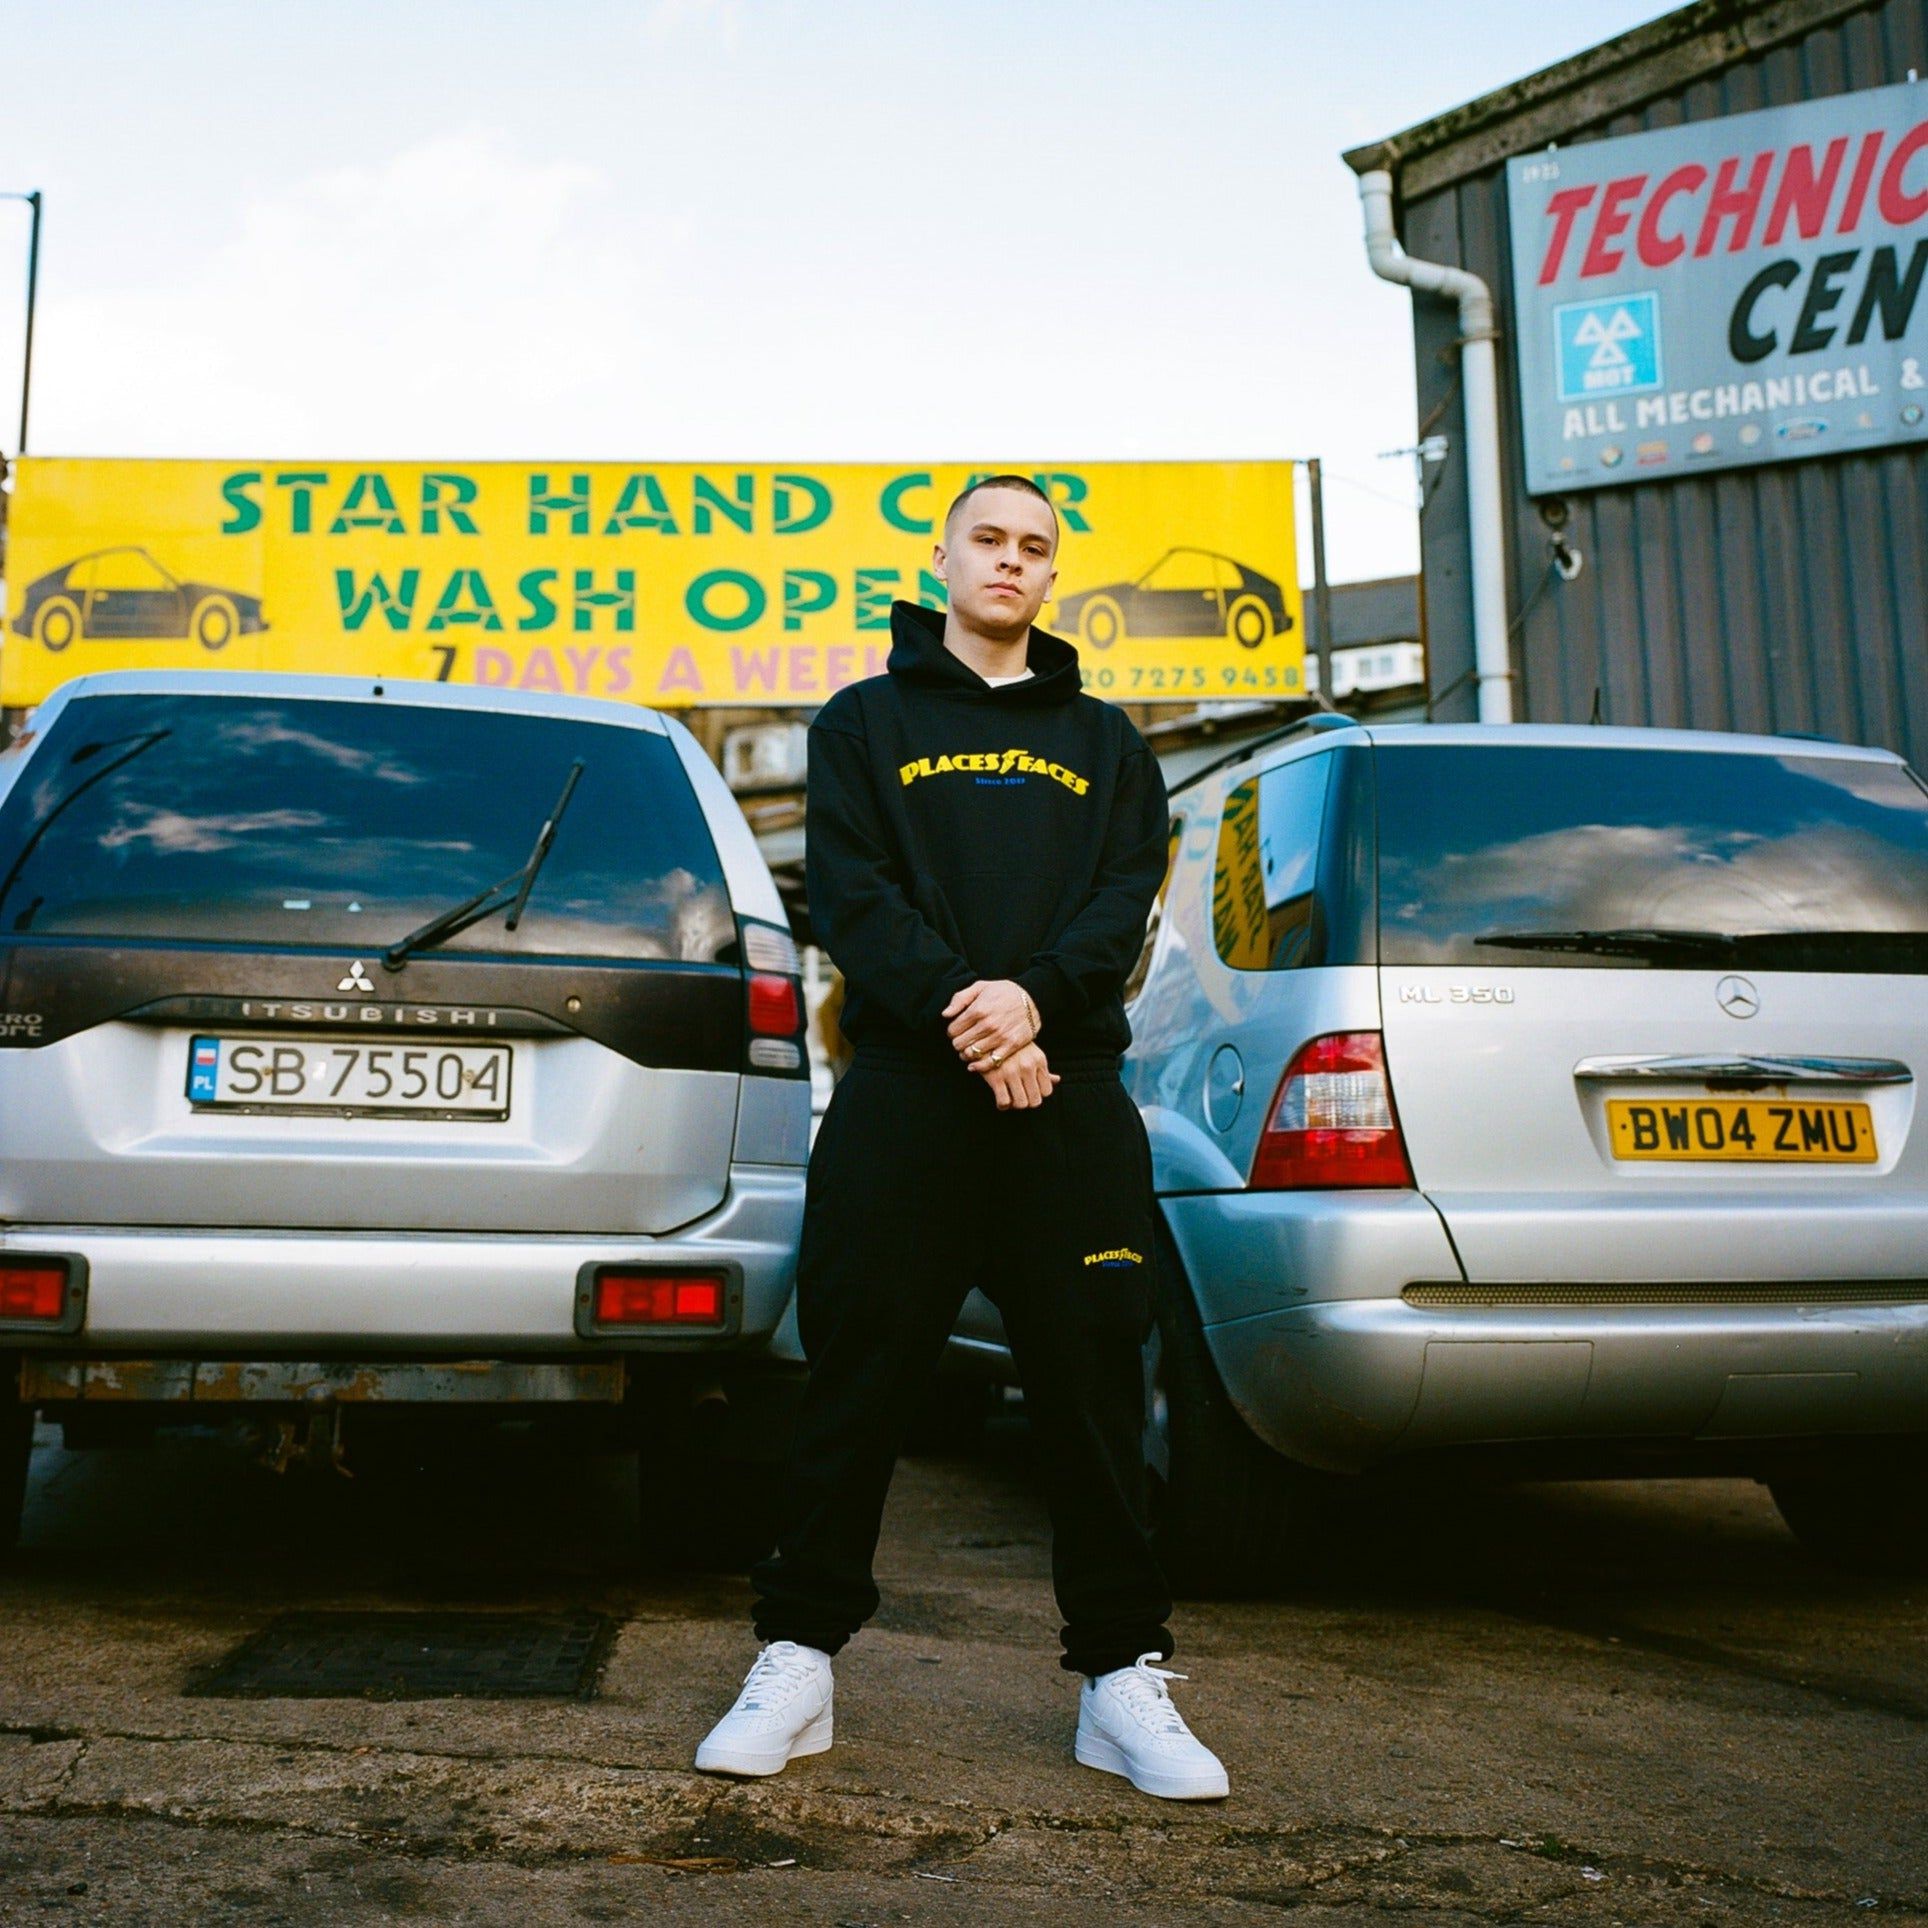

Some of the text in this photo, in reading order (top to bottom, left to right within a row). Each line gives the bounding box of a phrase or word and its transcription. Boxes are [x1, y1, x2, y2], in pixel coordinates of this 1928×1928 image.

[1536, 119, 1928, 287] TECHNIC
[1728, 237, 1928, 365] CEN
[1562, 357, 1925, 441] ALL MECHANICAL &
[220, 472, 1093, 535] STAR HAND CR
[334, 569, 636, 632] WASH
[431, 645, 457, 682] 7
[474, 645, 632, 692] DAYS
[658, 646, 704, 692] A
[1129, 668, 1207, 689] 7275
[1221, 667, 1300, 688] 9458
[900, 753, 1090, 796] PLACES FACES
[242, 1002, 497, 1026] ITSUBISHI
[1399, 984, 1516, 1004] ML 350
[193, 1075, 214, 1091] PL
[228, 1046, 500, 1102] SB 75504
[1628, 1107, 1858, 1153] BW04 ZMU
